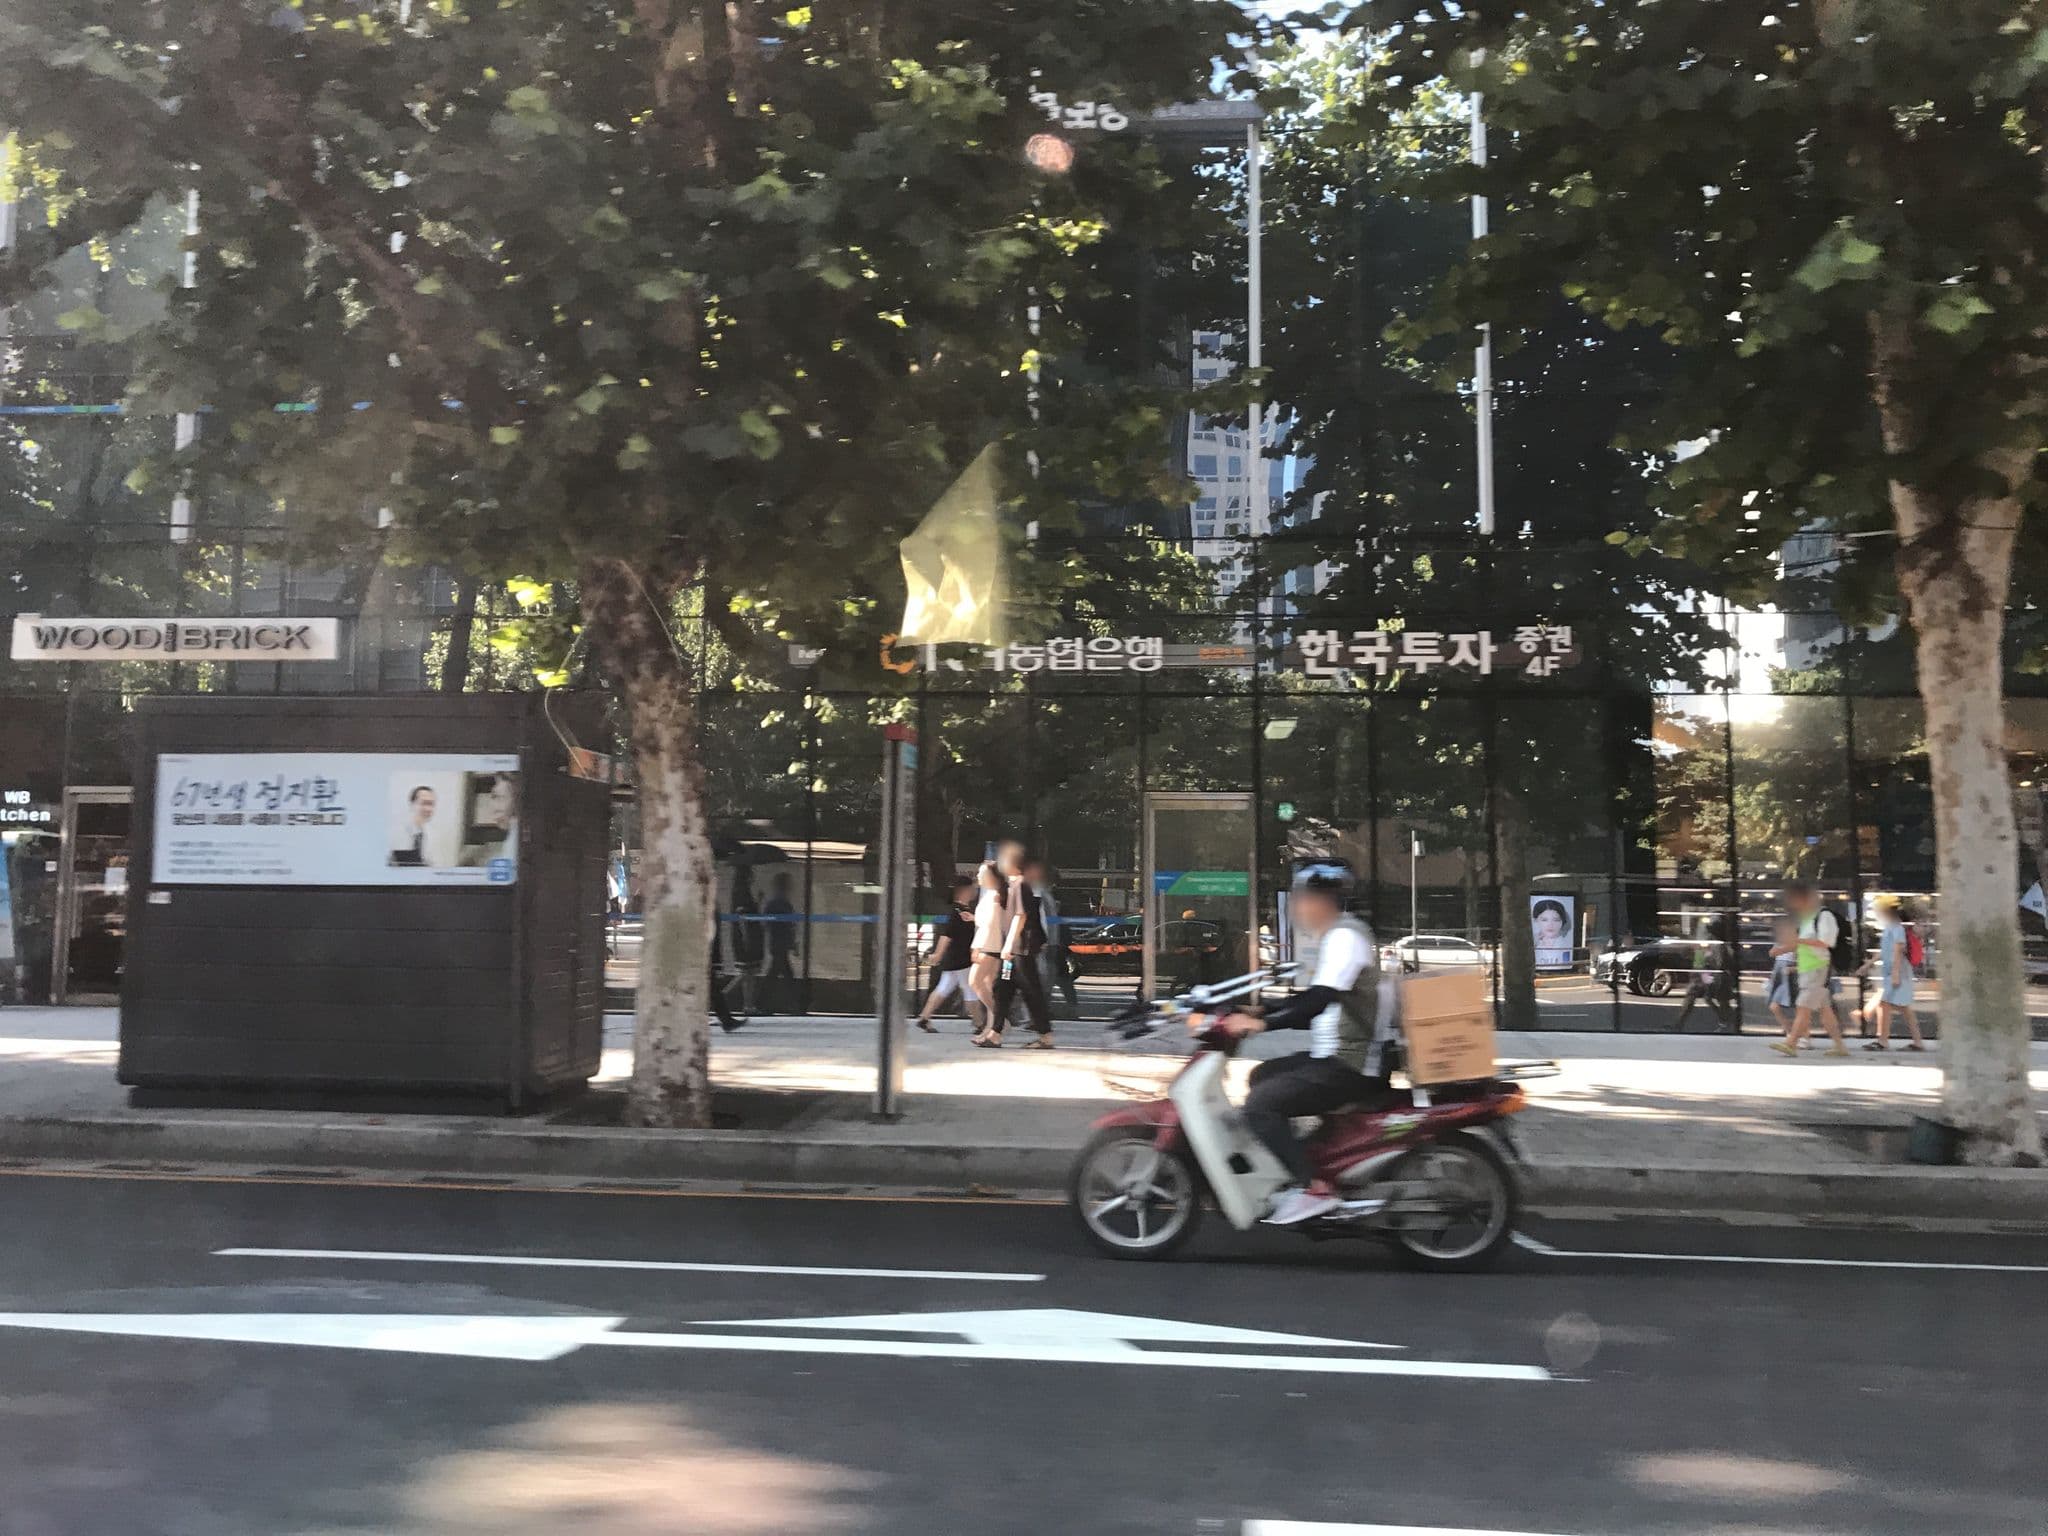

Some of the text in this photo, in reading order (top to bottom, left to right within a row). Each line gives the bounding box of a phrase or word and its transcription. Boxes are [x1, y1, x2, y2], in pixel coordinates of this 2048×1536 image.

[31, 625, 161, 650] WOOD
[179, 624, 312, 650] BRICK
[1296, 625, 1572, 679] 한국투자 증권
[1525, 655, 1560, 677] 4F
[4, 790, 31, 804] WB
